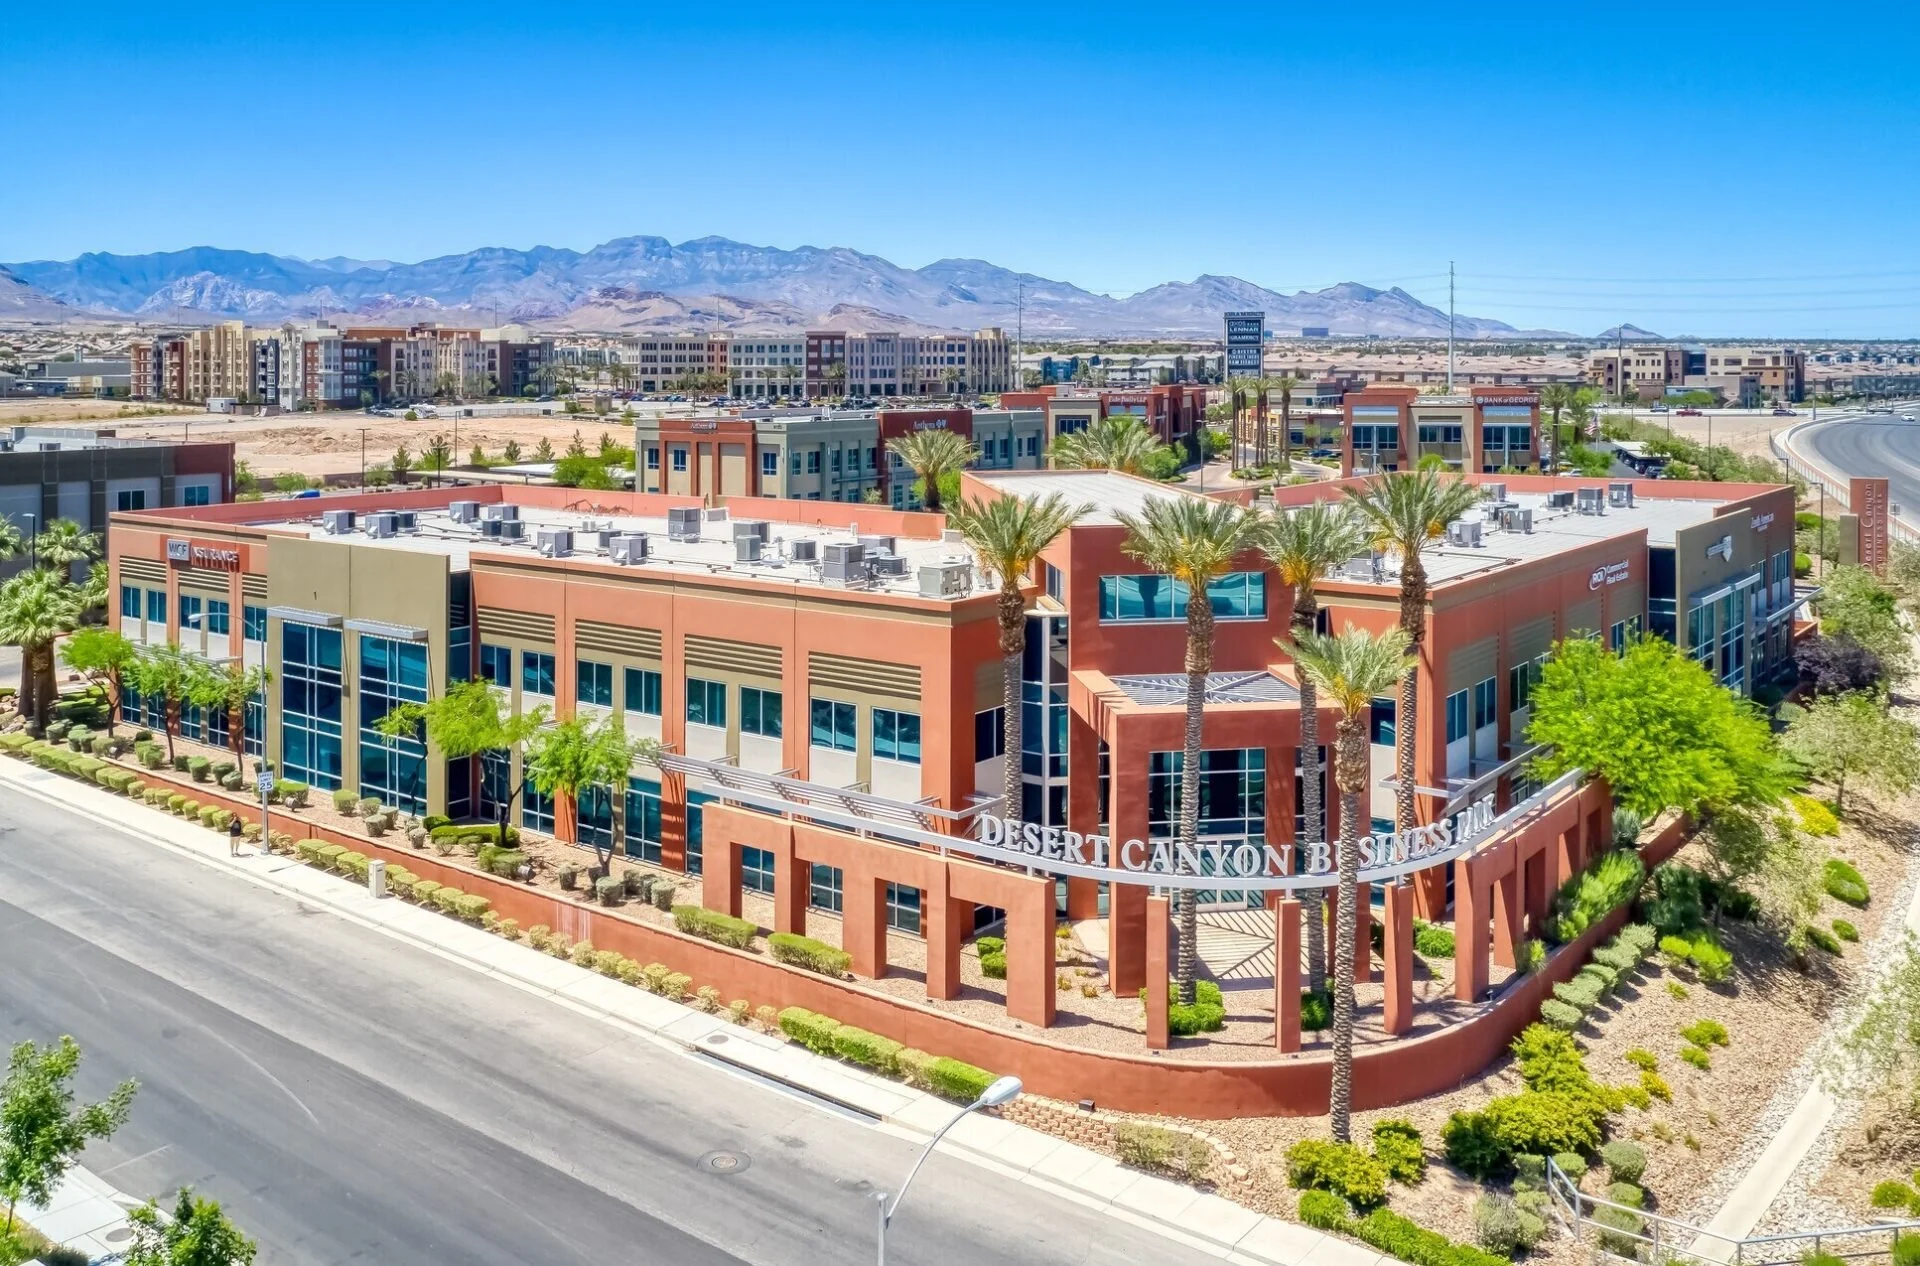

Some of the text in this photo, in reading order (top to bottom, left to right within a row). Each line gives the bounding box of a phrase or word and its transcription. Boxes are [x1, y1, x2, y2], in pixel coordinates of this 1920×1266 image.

[1860, 484, 1875, 527] Canyon
[168, 543, 187, 554] WCF
[260, 782, 272, 790] 25
[980, 812, 1110, 867] DESERT
[1121, 839, 1292, 878] CANYON
